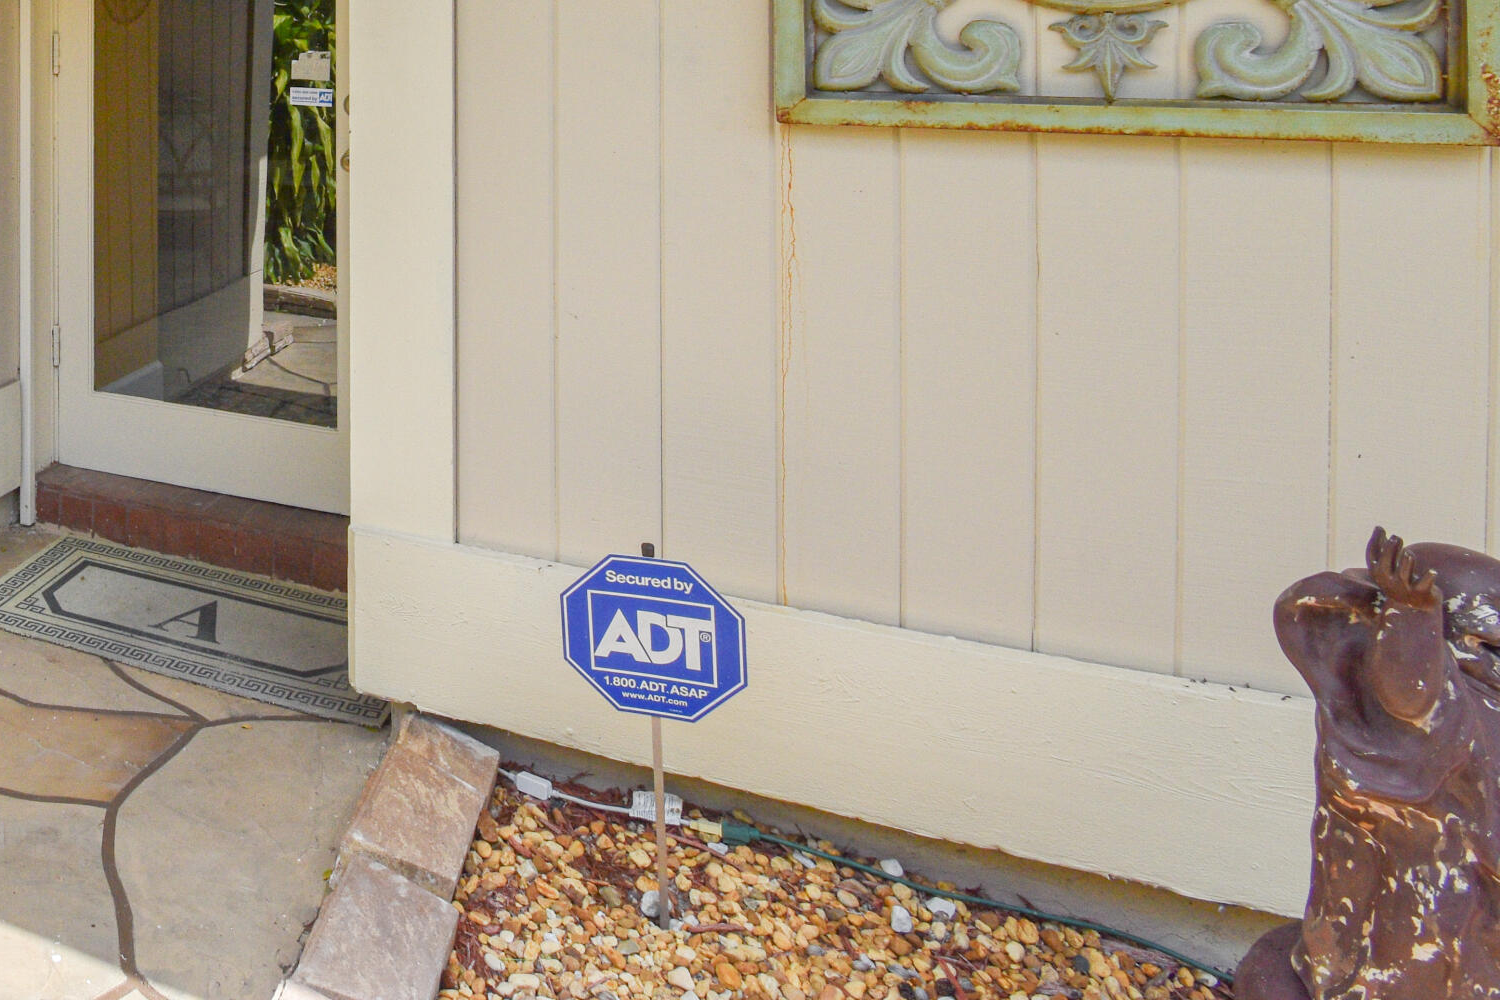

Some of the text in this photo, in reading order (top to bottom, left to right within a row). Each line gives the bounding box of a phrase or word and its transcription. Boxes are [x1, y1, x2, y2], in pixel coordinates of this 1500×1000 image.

[605, 570, 694, 594] Secured by
[148, 600, 220, 645] A
[603, 676, 708, 699] 1.800.ADT.ASAP
[621, 691, 688, 707] www.ADT.com
